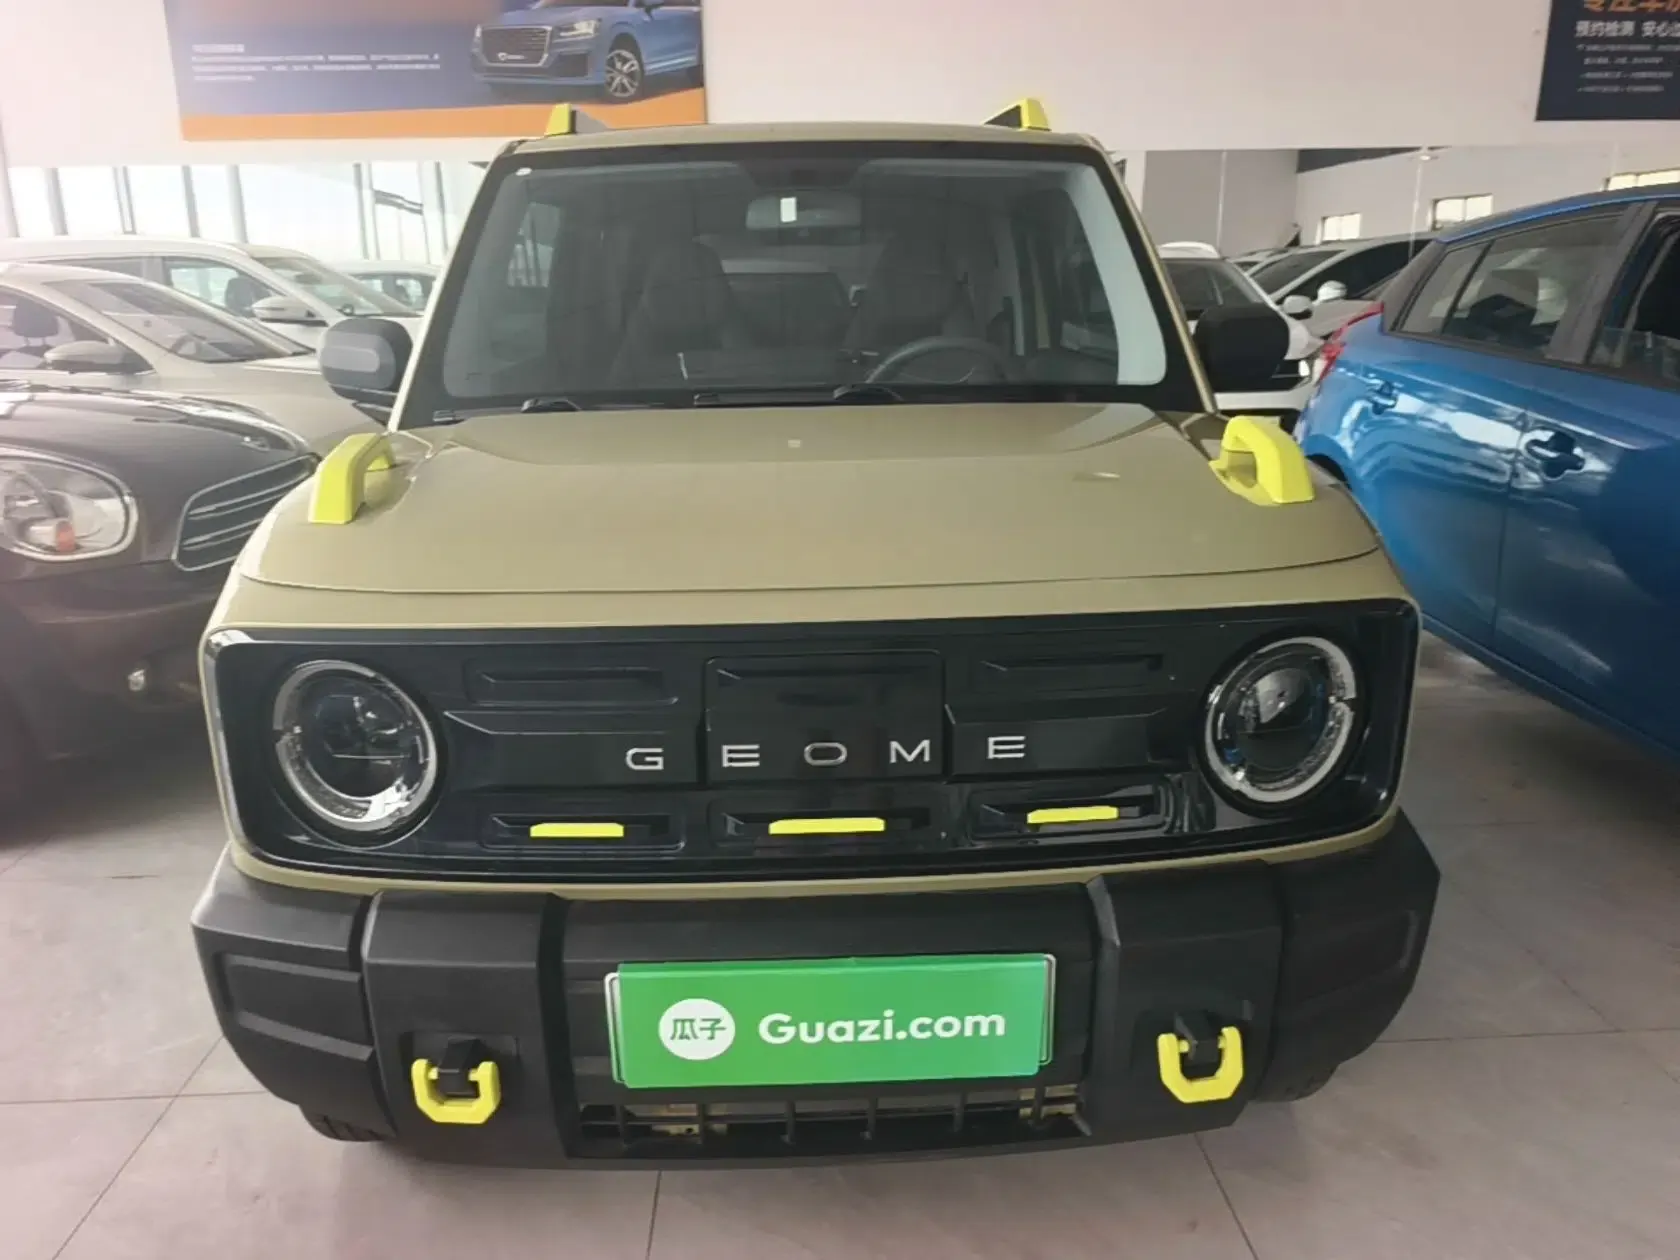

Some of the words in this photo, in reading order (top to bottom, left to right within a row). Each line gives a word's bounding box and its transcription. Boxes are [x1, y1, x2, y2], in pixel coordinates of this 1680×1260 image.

[626, 735, 1026, 771] GEOME
[670, 1017, 726, 1041] 瓜子
[758, 1009, 1006, 1045] Guazi.com
